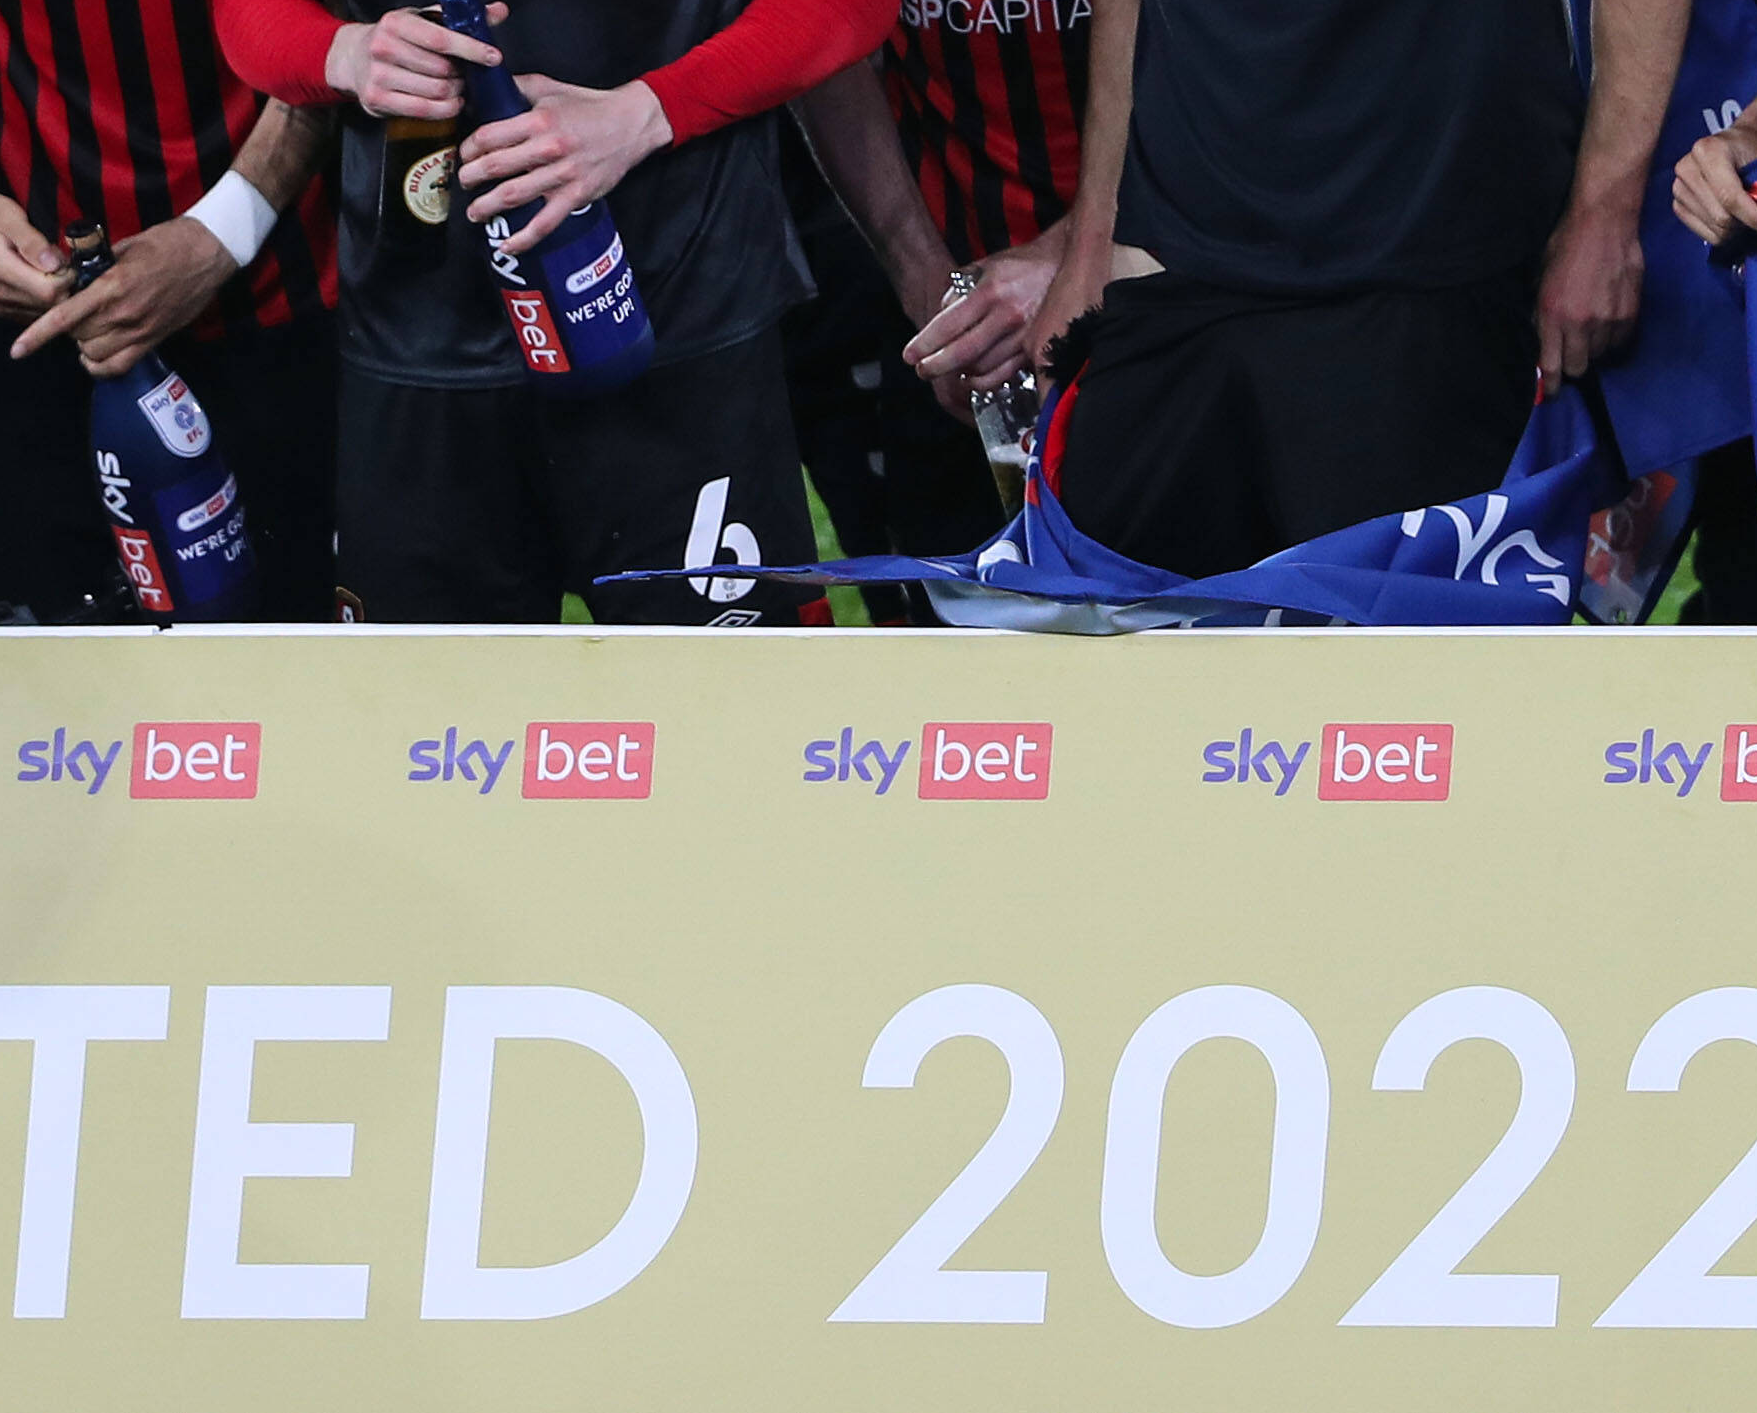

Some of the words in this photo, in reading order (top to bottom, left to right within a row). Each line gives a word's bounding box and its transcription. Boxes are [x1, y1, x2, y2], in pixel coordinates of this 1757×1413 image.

[408, 156, 442, 194] BIRRA
[565, 294, 616, 325] WE'RE
[574, 270, 594, 287] sky
[612, 297, 636, 325] UP!
[510, 297, 559, 365] bet
[97, 449, 134, 525] sky
[119, 534, 162, 604] bet
[175, 526, 226, 562] WE'RE
[684, 476, 762, 603] 6
[18, 727, 124, 794] sky
[144, 730, 247, 782] bet
[408, 727, 516, 794] sky
[536, 730, 640, 782] bet
[804, 727, 912, 794] sky
[933, 730, 1038, 783] bet
[1203, 728, 1311, 796] sky
[1333, 730, 1439, 784] bet
[1605, 728, 1714, 796] sky
